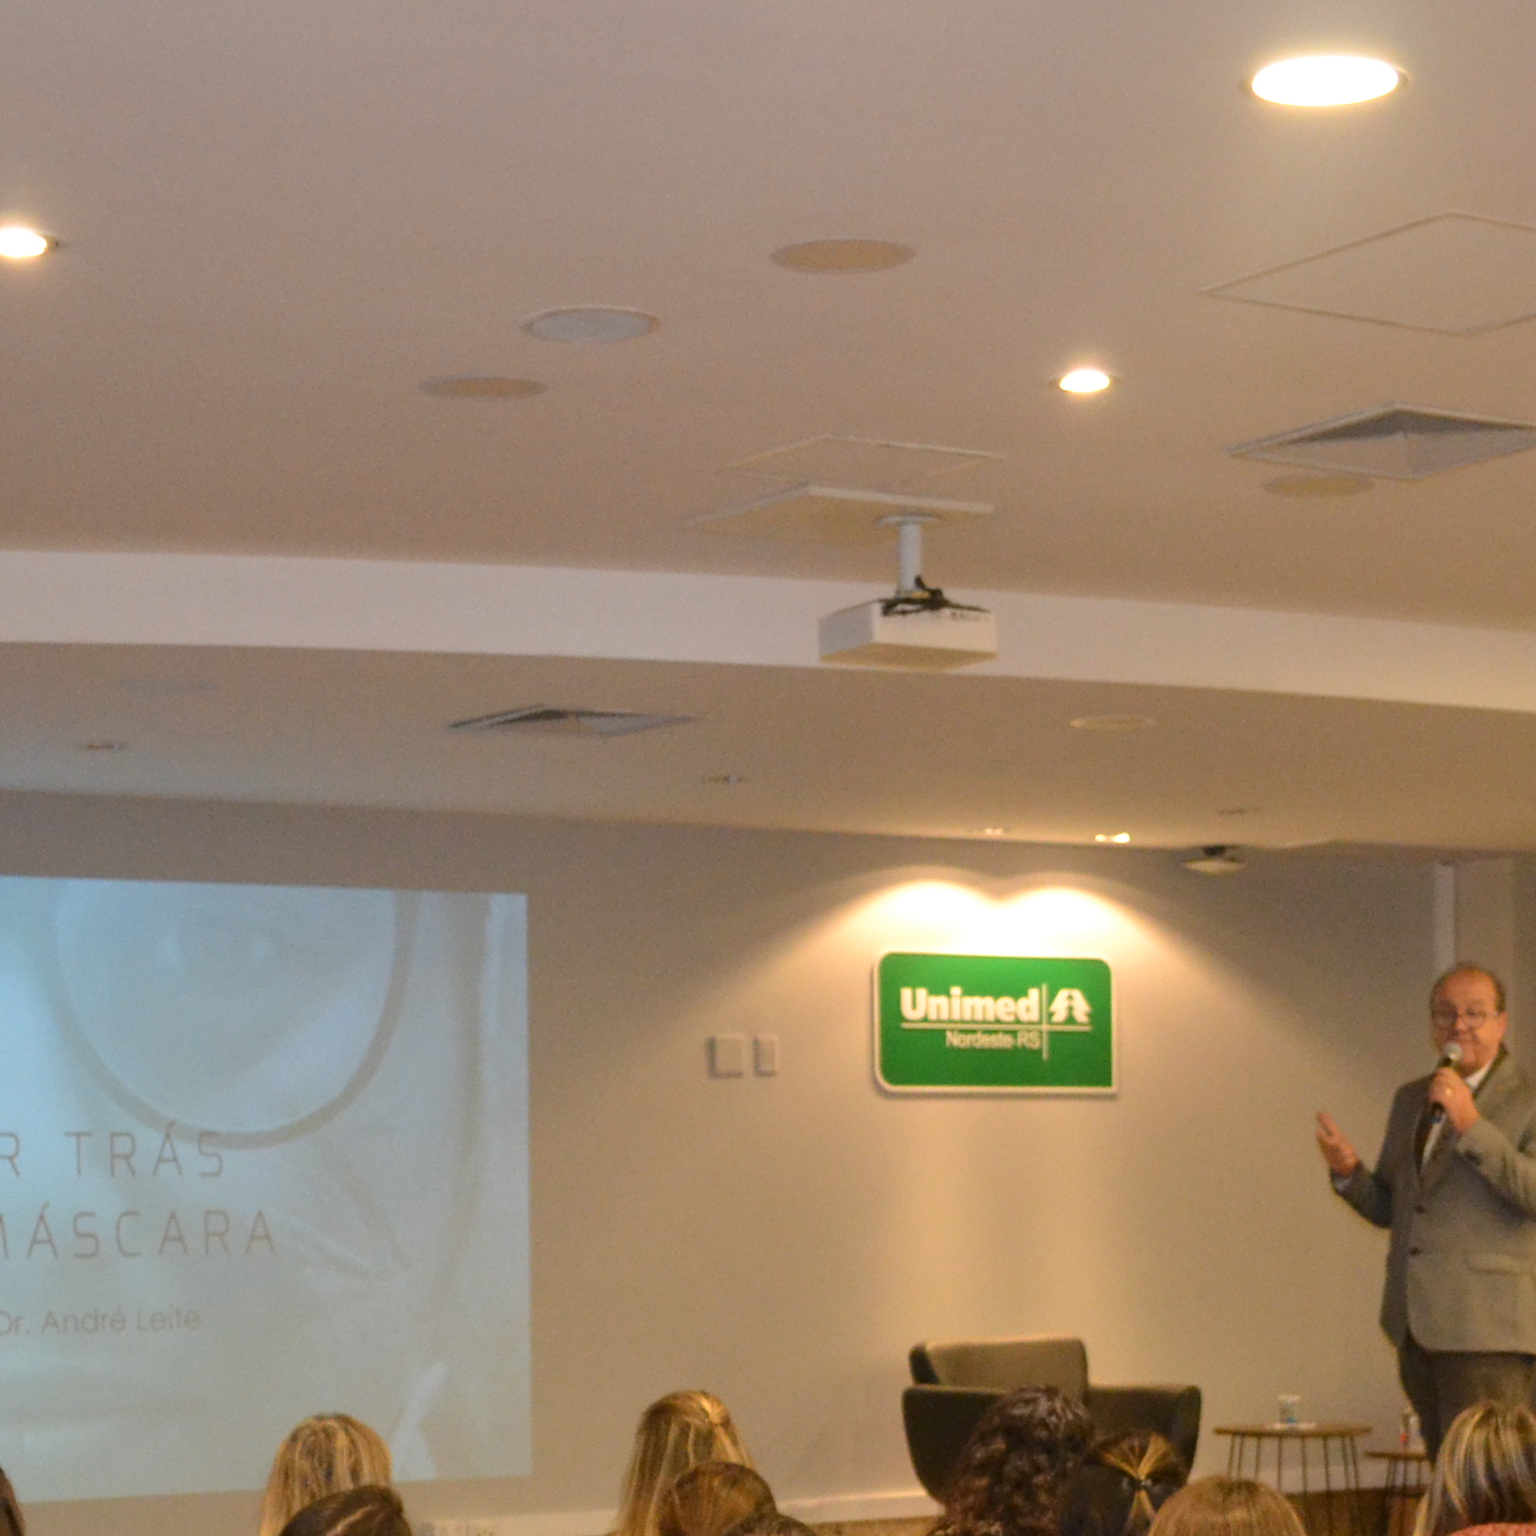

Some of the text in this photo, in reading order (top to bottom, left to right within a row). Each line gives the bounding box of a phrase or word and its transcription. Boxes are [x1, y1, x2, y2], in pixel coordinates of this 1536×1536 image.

[900, 986, 1041, 1022] Unimed
[63, 1119, 224, 1178] TRÁS
[41, 1305, 126, 1335] André
[136, 1303, 202, 1331] Leite
